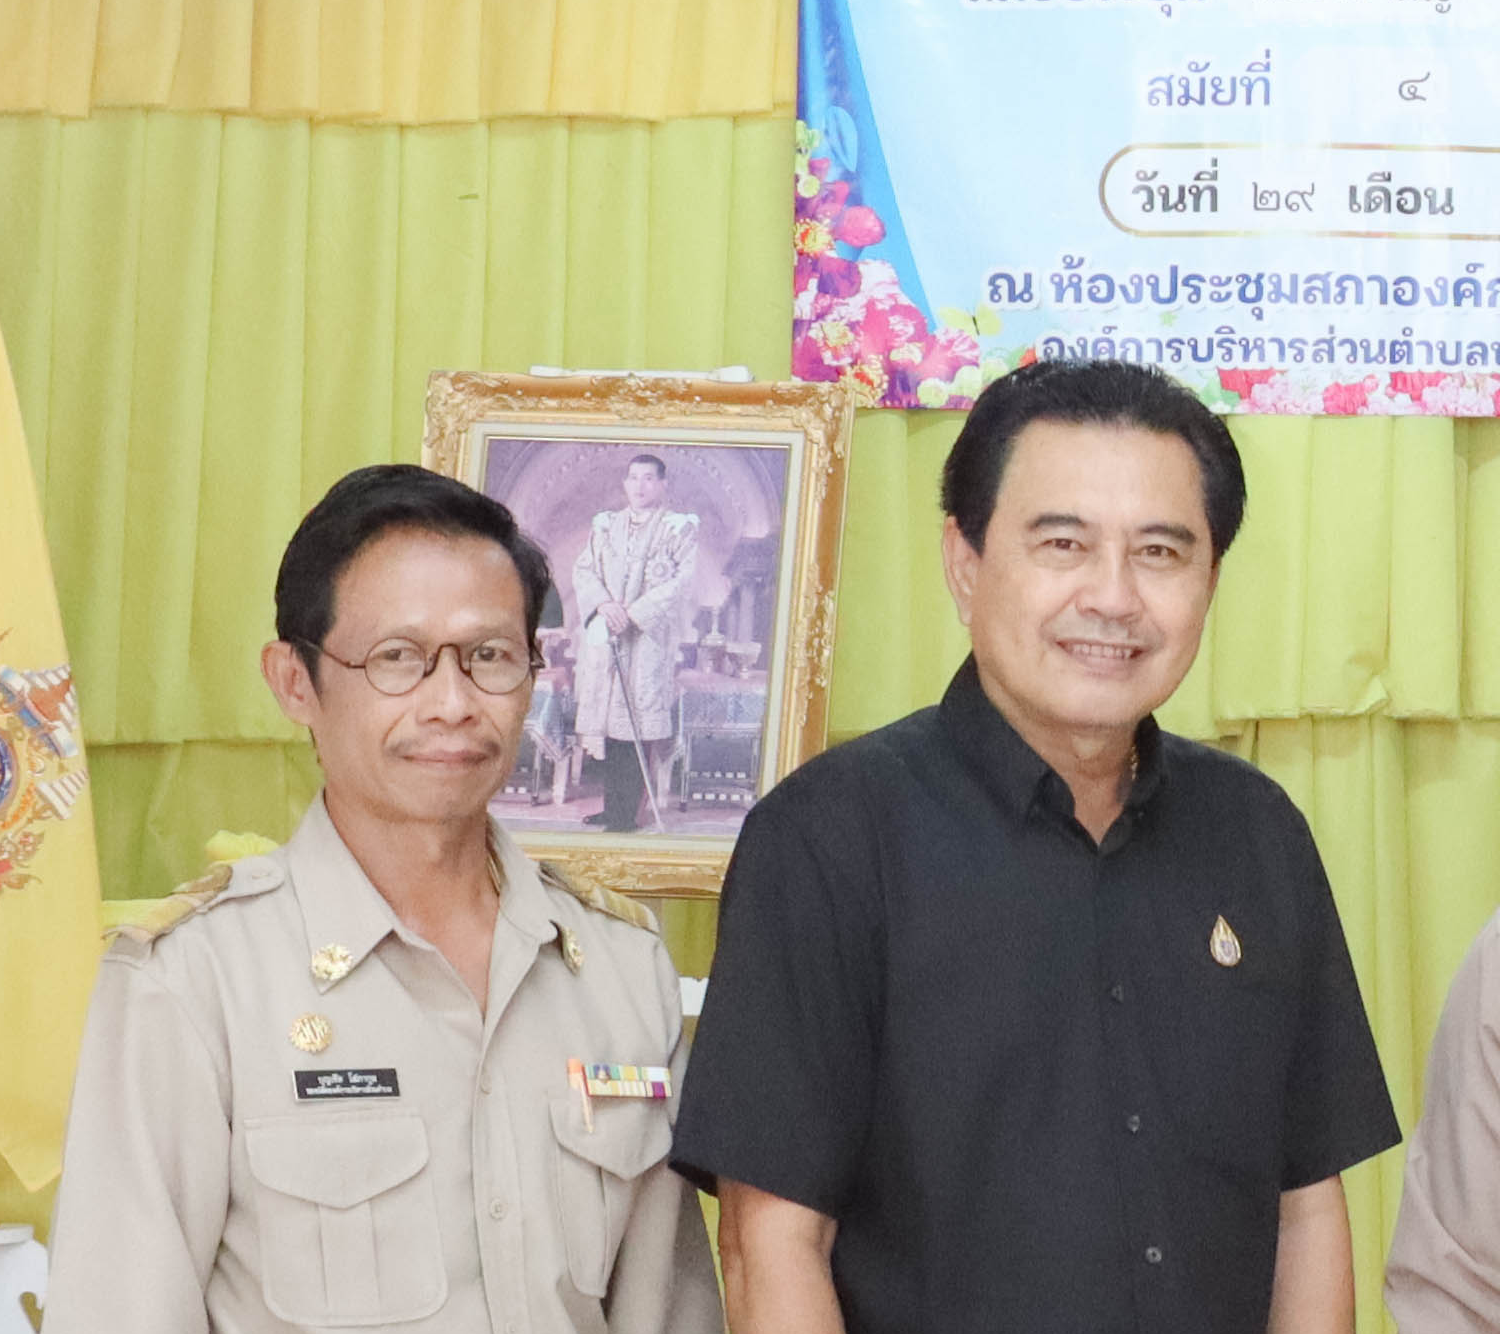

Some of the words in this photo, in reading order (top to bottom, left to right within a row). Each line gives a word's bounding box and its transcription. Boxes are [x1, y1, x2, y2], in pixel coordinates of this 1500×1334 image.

[1146, 49, 1273, 107] สมัยที่
[1397, 72, 1431, 102] ๔
[1130, 157, 1219, 214] วันที่
[1250, 180, 1316, 213] ๒๙
[1347, 171, 1455, 217] เดือน
[986, 270, 1034, 305] ณ
